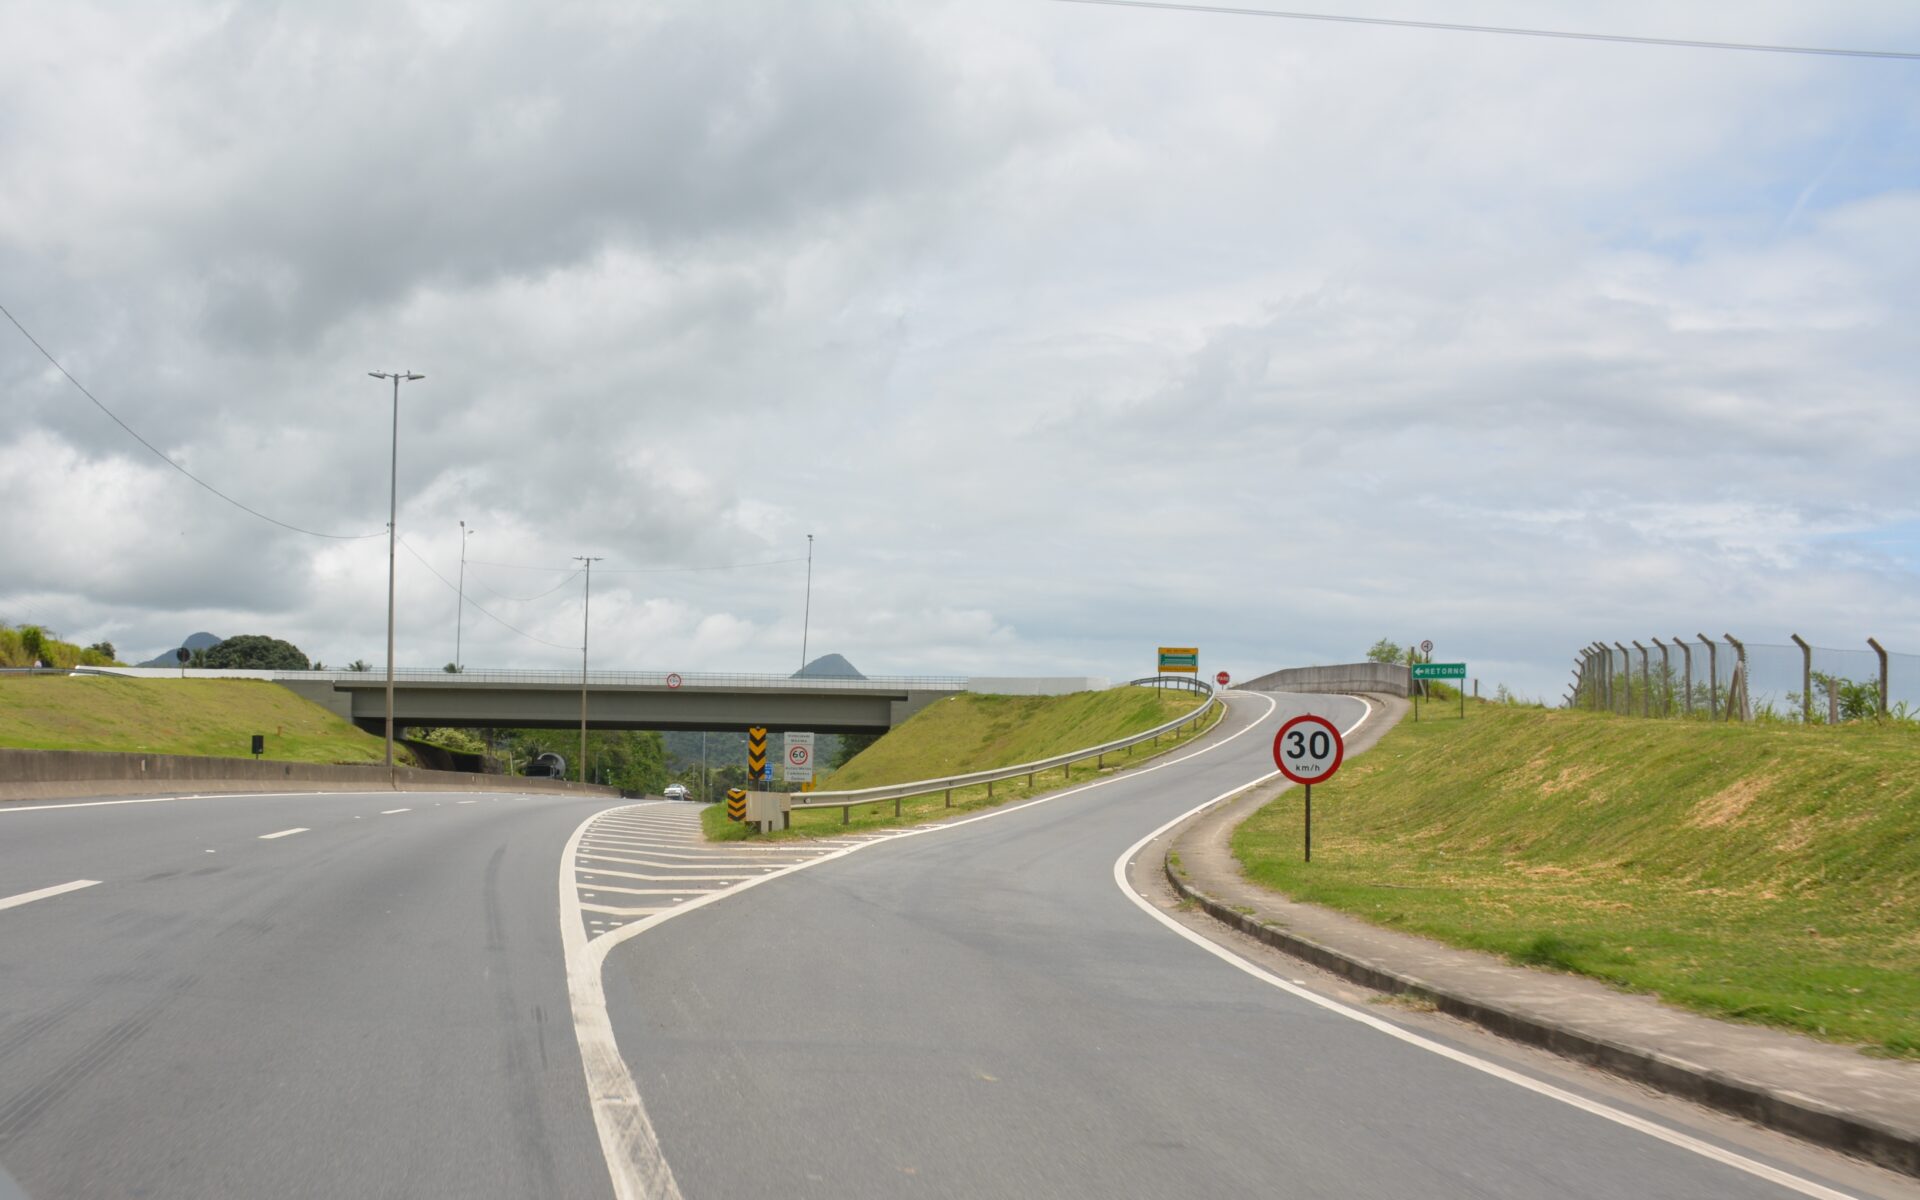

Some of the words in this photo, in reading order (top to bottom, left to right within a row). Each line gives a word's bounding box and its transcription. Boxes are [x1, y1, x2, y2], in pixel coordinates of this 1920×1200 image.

[1424, 667, 1465, 675] RETORNO
[1286, 730, 1330, 760] 30
[792, 750, 806, 759] 60
[1295, 764, 1320, 772] km/h
